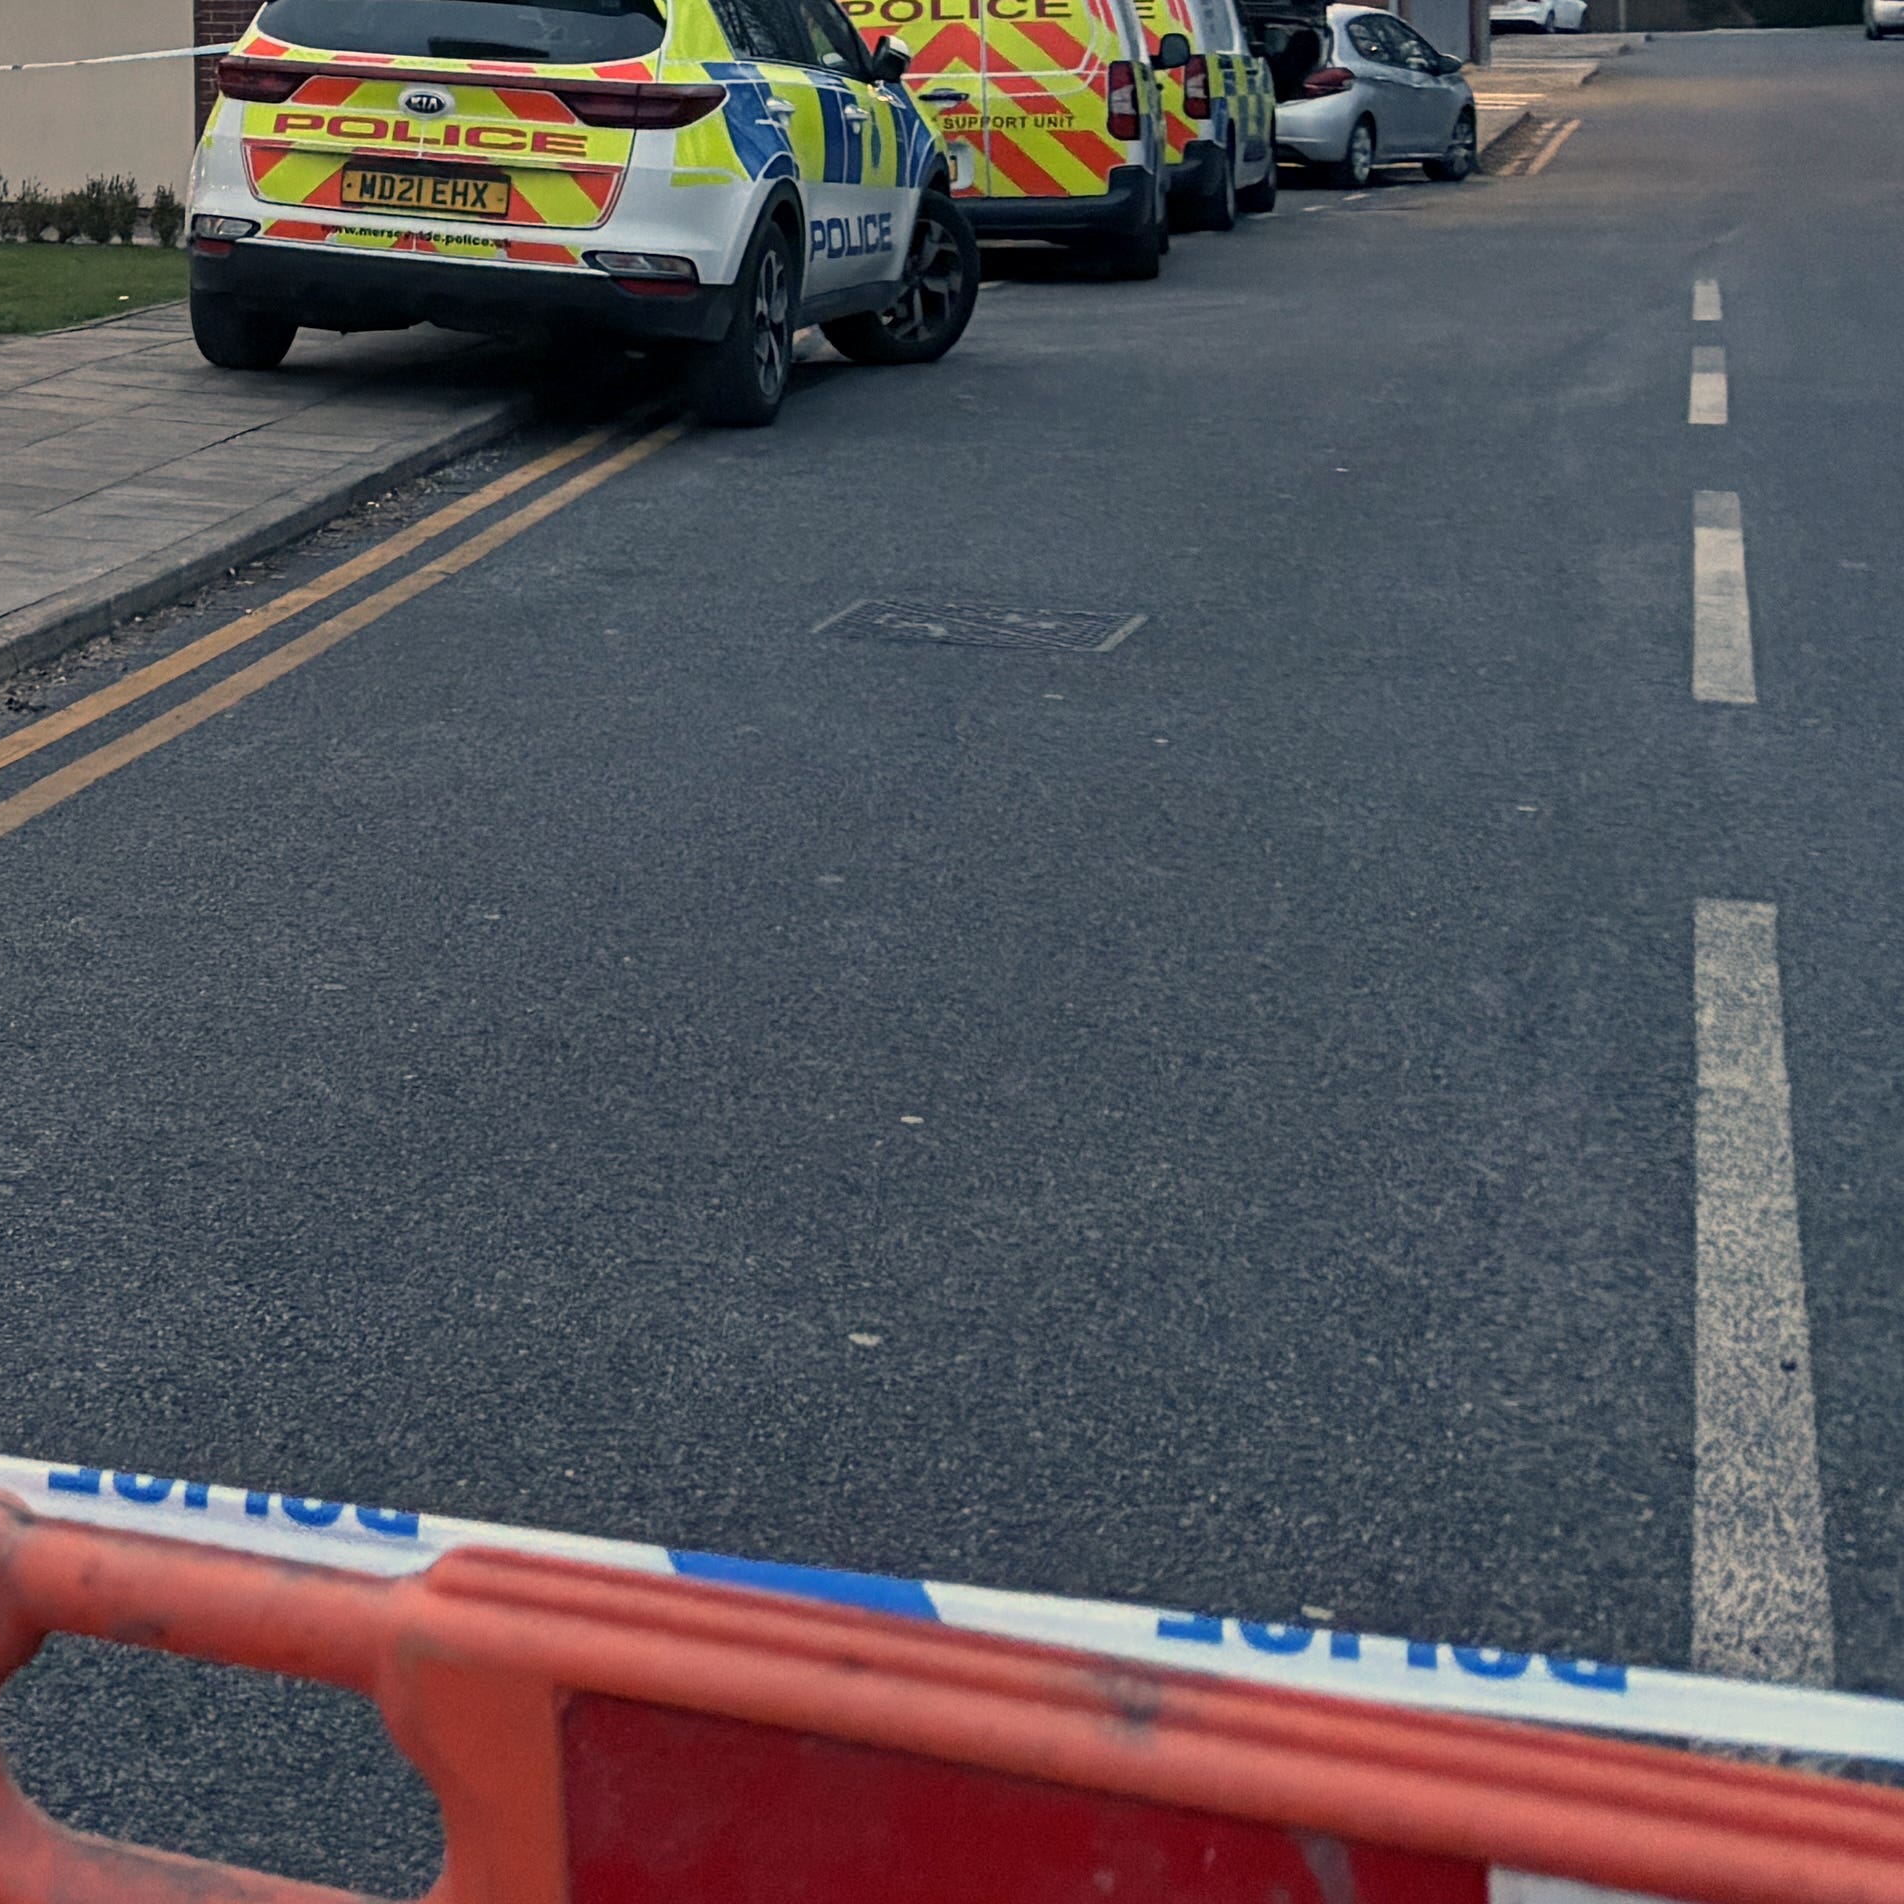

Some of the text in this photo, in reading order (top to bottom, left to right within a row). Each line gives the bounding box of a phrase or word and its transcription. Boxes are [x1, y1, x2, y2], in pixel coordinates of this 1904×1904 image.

[410, 95, 440, 112] KIA
[943, 114, 1075, 130] SUPPORT UNIT
[273, 112, 588, 157] POLICE
[359, 172, 488, 210] MD21 EHX
[809, 211, 892, 263] POLICE
